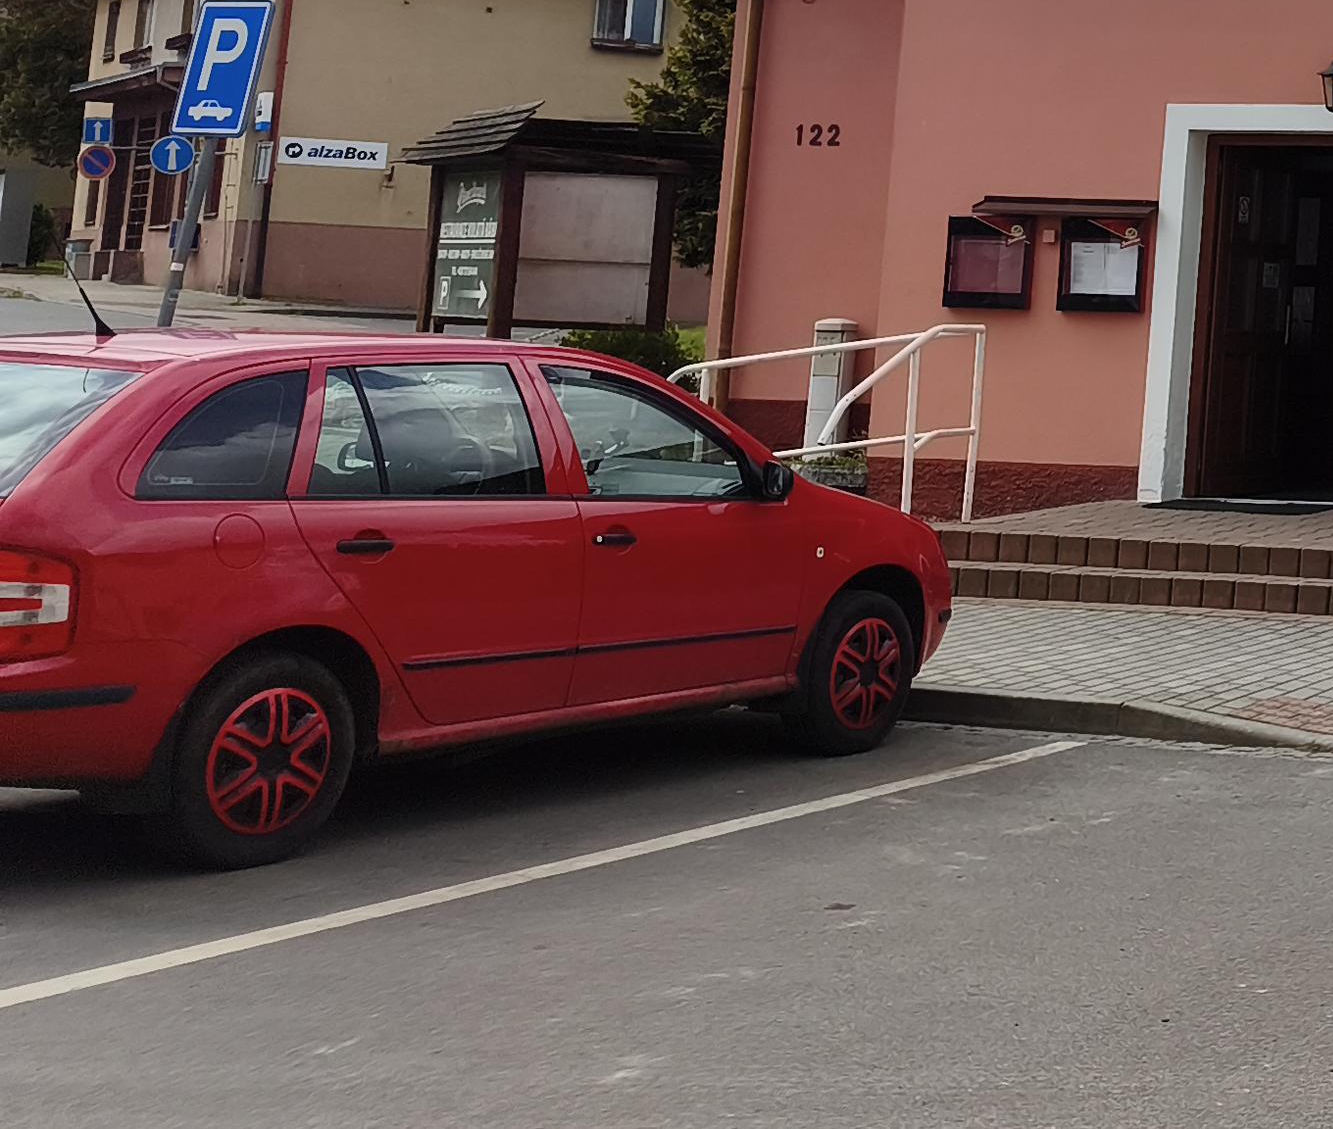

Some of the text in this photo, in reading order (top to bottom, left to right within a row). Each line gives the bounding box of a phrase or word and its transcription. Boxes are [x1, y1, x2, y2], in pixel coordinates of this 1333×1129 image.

[197, 18, 248, 91] P
[796, 123, 841, 147] 122
[307, 145, 379, 161] alzaBox
